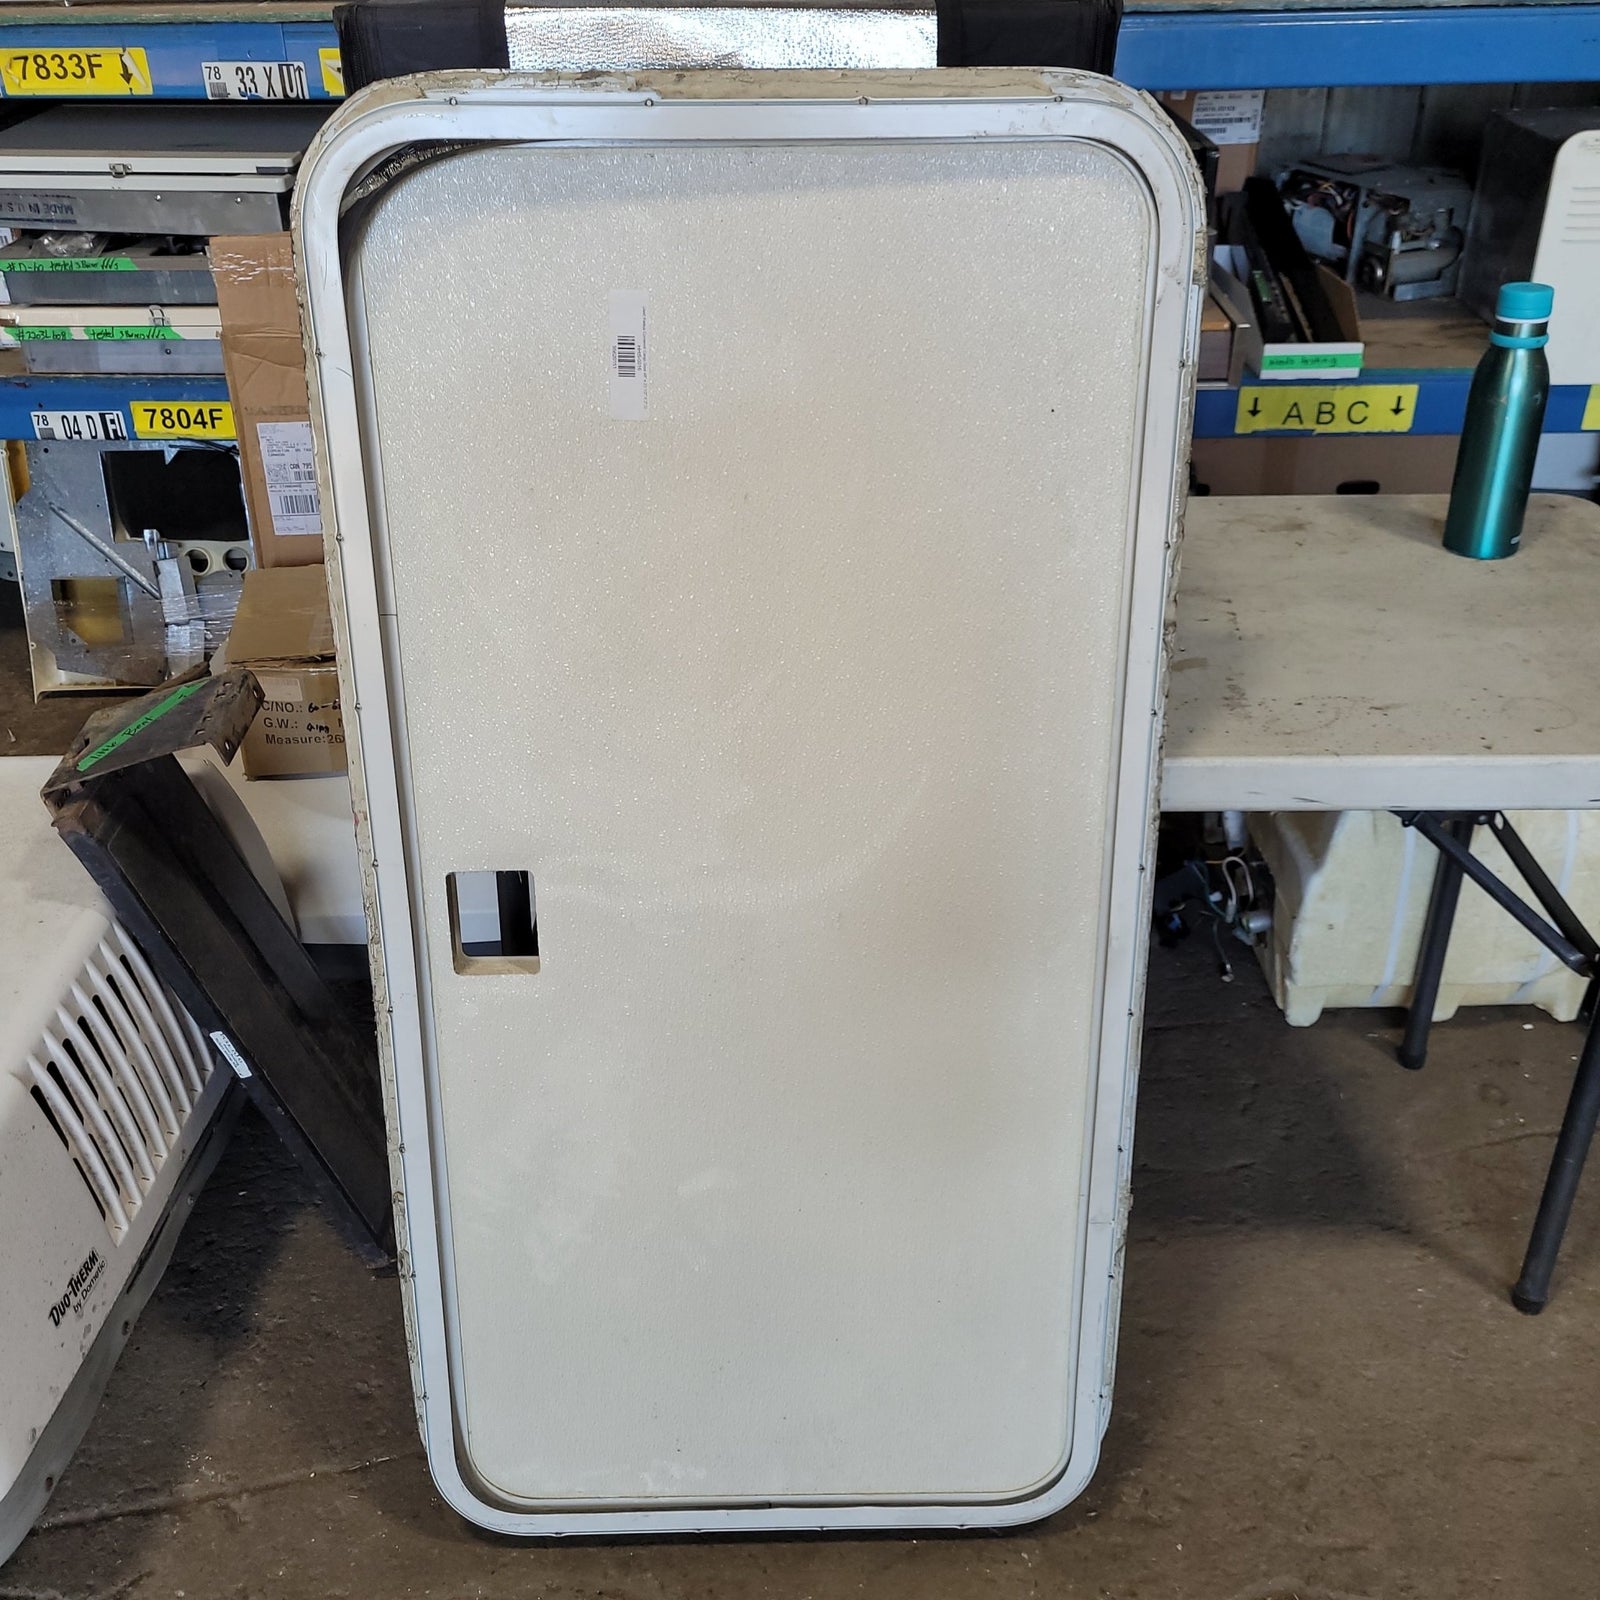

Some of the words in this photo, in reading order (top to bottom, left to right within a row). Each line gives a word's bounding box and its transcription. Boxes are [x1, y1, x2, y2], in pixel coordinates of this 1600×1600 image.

[13, 53, 103, 81] 7833F
[204, 66, 222, 80] 78
[235, 66, 259, 98] 33
[262, 66, 283, 98] X
[33, 414, 49, 427] 78
[61, 414, 83, 440] 04
[86, 414, 99, 440] D
[143, 408, 224, 429] 7804F
[261, 701, 303, 713] C/NO.:
[263, 717, 298, 729] G.W.:
[73, 1299, 82, 1314] by
[81, 1260, 106, 1301] Dometic
